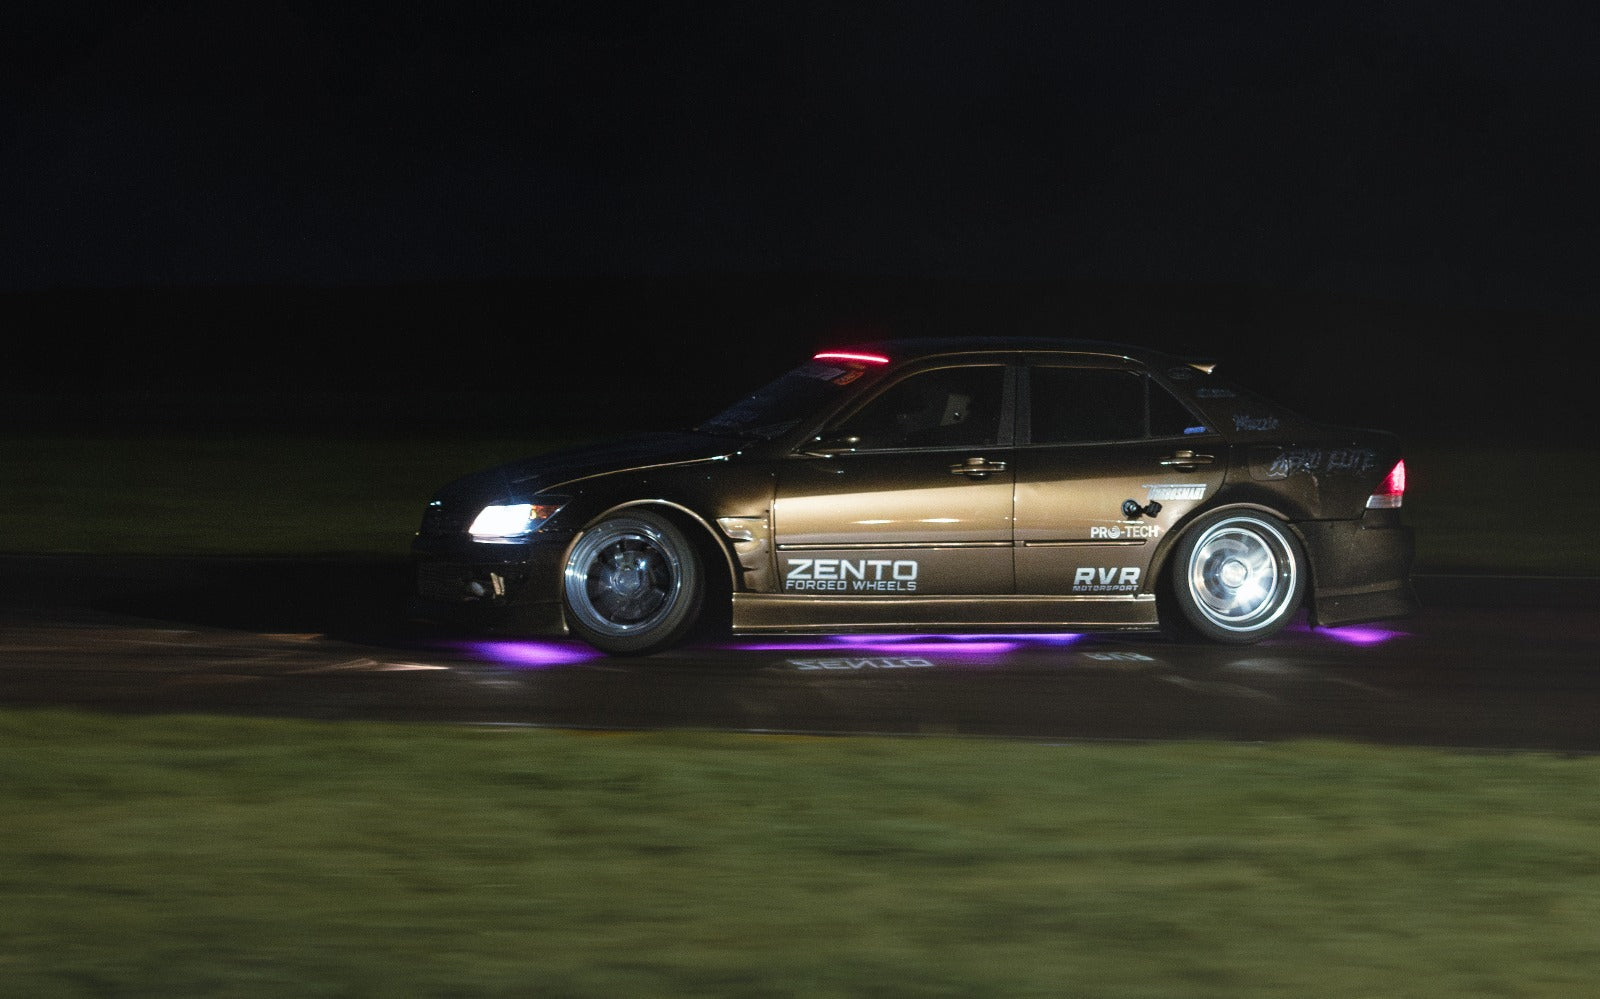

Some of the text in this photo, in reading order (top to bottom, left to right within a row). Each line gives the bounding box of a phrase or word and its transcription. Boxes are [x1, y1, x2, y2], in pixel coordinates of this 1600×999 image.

[1090, 525, 1159, 538] PRO-TECH
[786, 558, 918, 580] ZENTO
[1073, 567, 1141, 584] RVR
[785, 580, 917, 591] FORGED WHEELS
